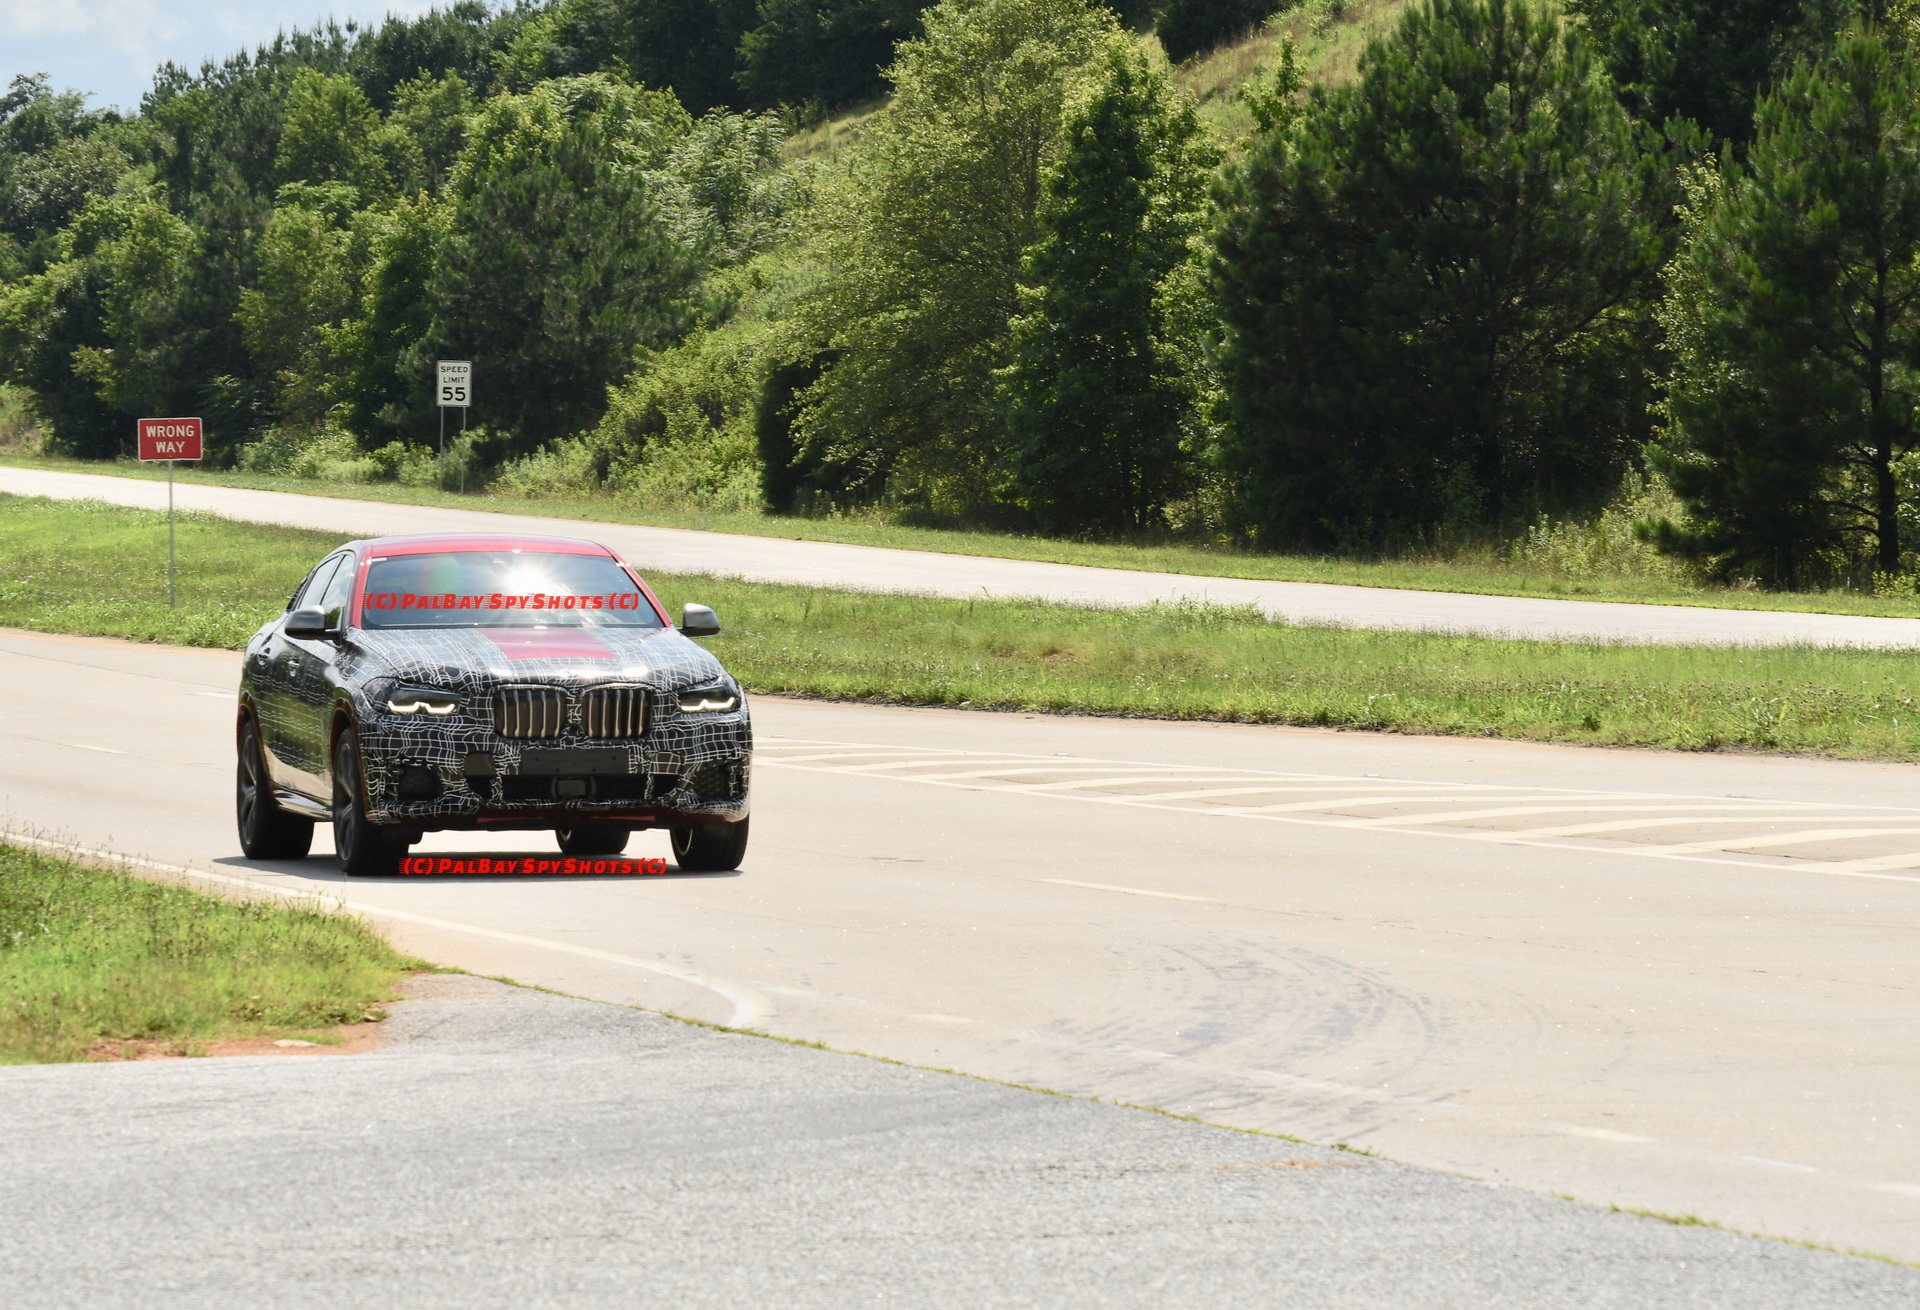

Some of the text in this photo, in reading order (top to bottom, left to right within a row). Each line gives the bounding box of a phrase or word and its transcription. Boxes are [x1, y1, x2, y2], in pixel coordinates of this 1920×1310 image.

[440, 365, 469, 373] SPEED
[443, 376, 465, 384] LIMIT
[442, 386, 466, 402] 55
[145, 424, 195, 438] WRONG
[155, 441, 186, 454] WAY
